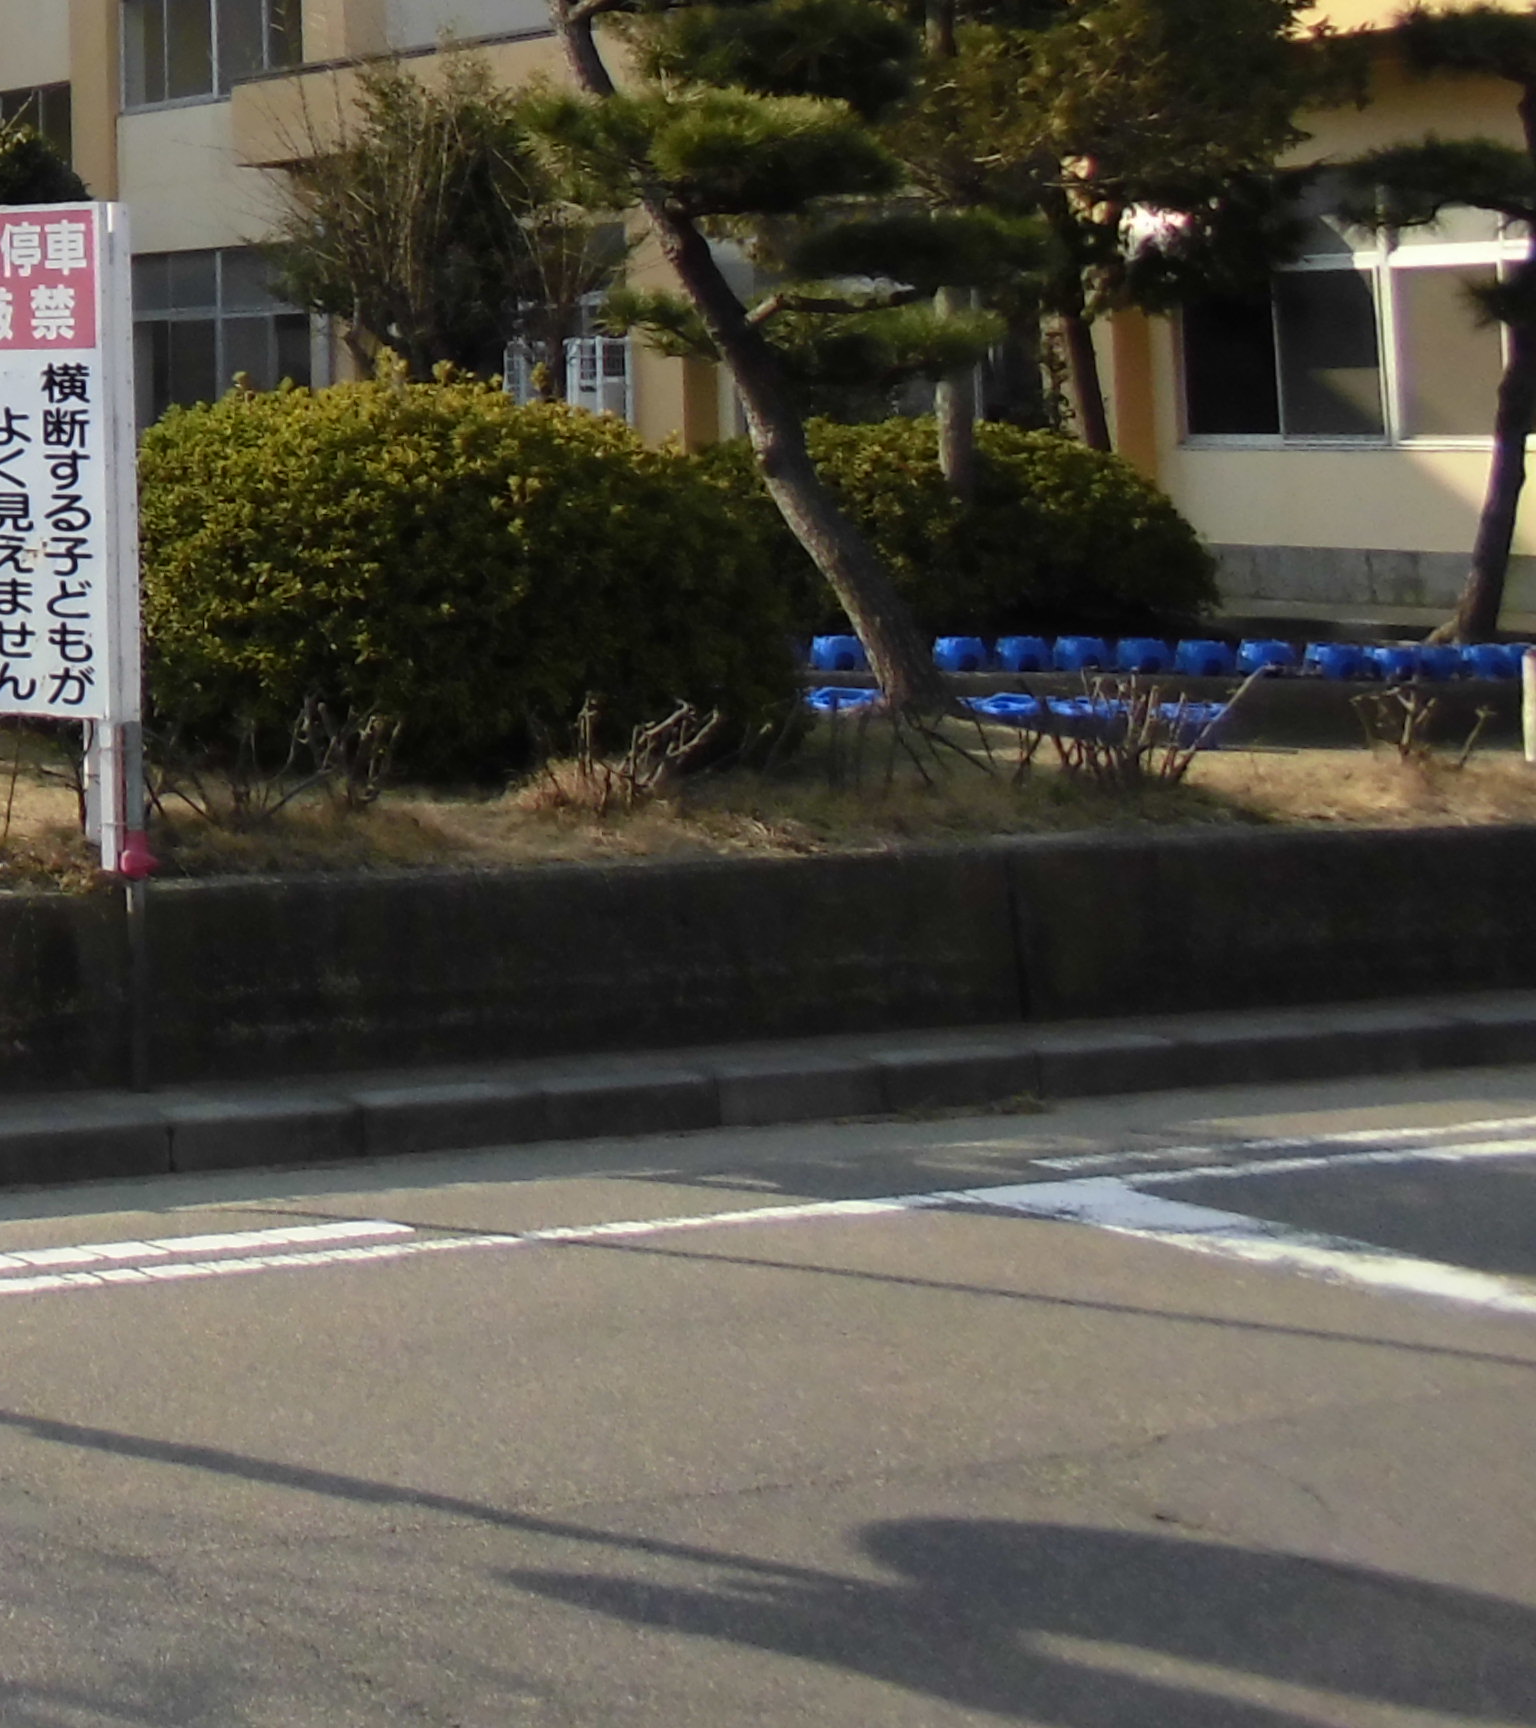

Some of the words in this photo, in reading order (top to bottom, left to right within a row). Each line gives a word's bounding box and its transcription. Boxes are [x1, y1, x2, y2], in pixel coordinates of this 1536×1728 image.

[40, 363, 95, 706] 横断する子どもが
